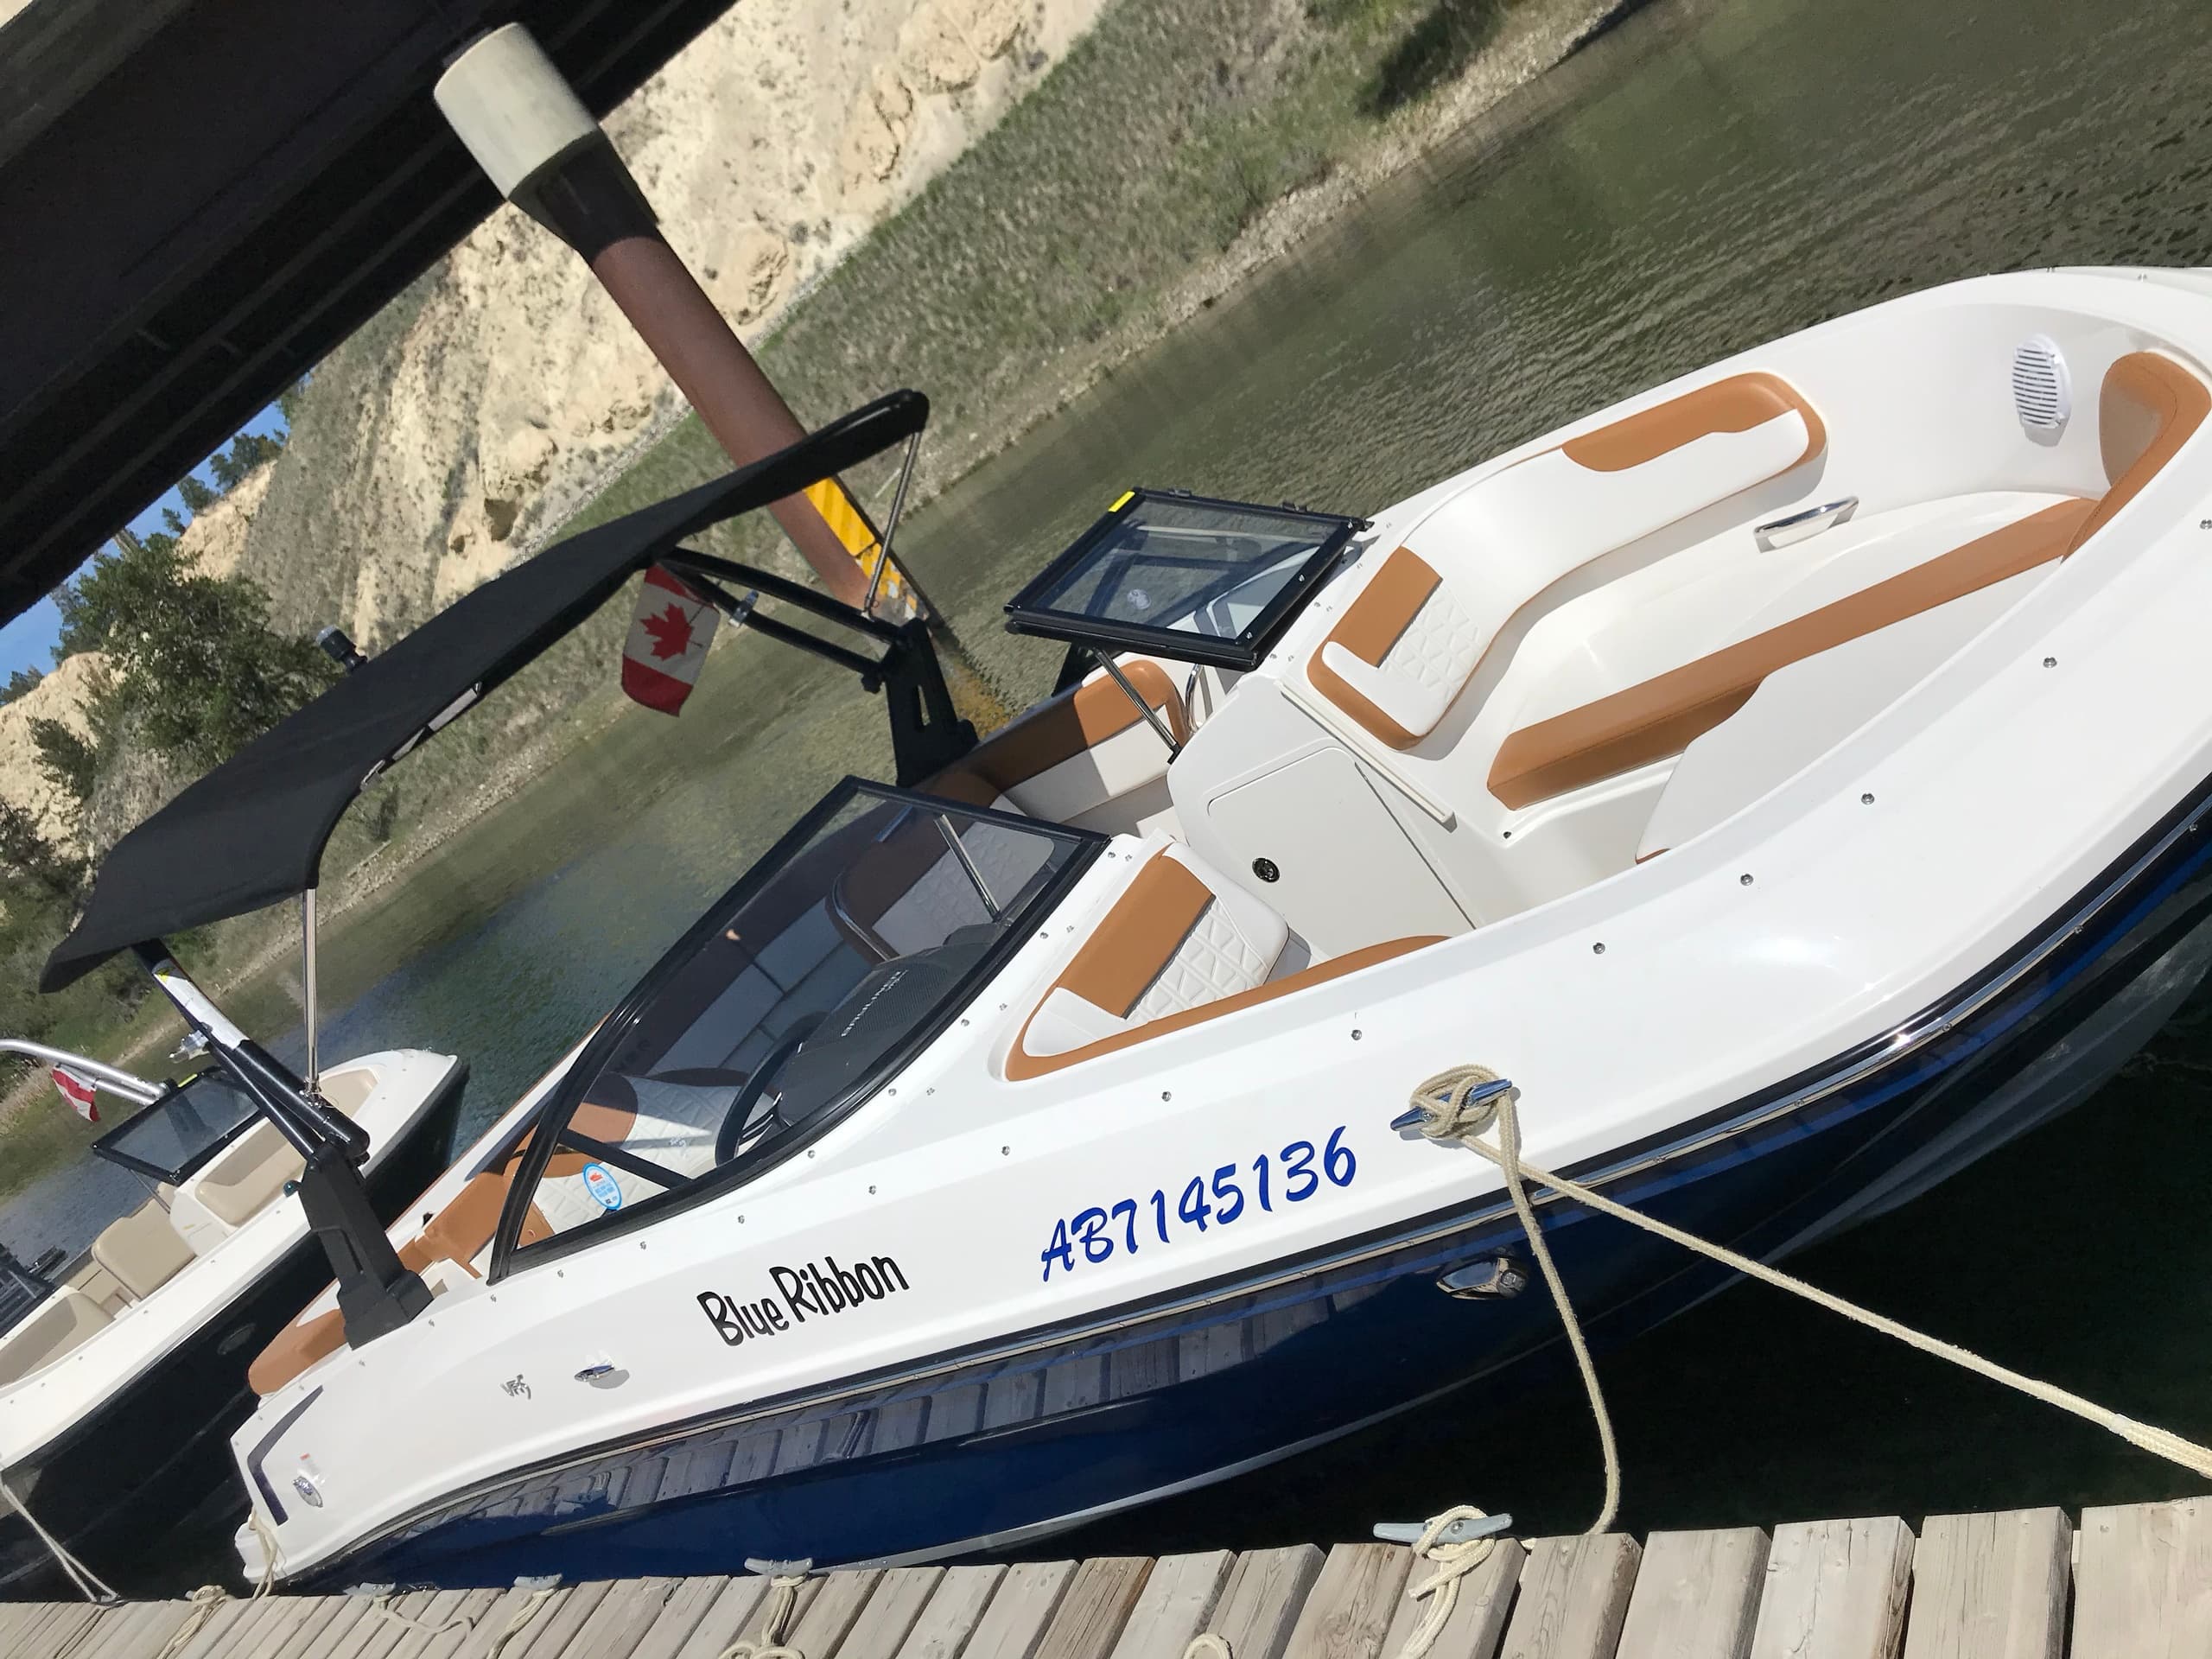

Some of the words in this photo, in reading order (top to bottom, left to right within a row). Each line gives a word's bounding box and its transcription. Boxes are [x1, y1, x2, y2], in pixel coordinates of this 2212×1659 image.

[1041, 1127, 1356, 1281] AB7145136
[697, 1291, 790, 1346] Blue
[769, 1255, 910, 1323] Ribbon
